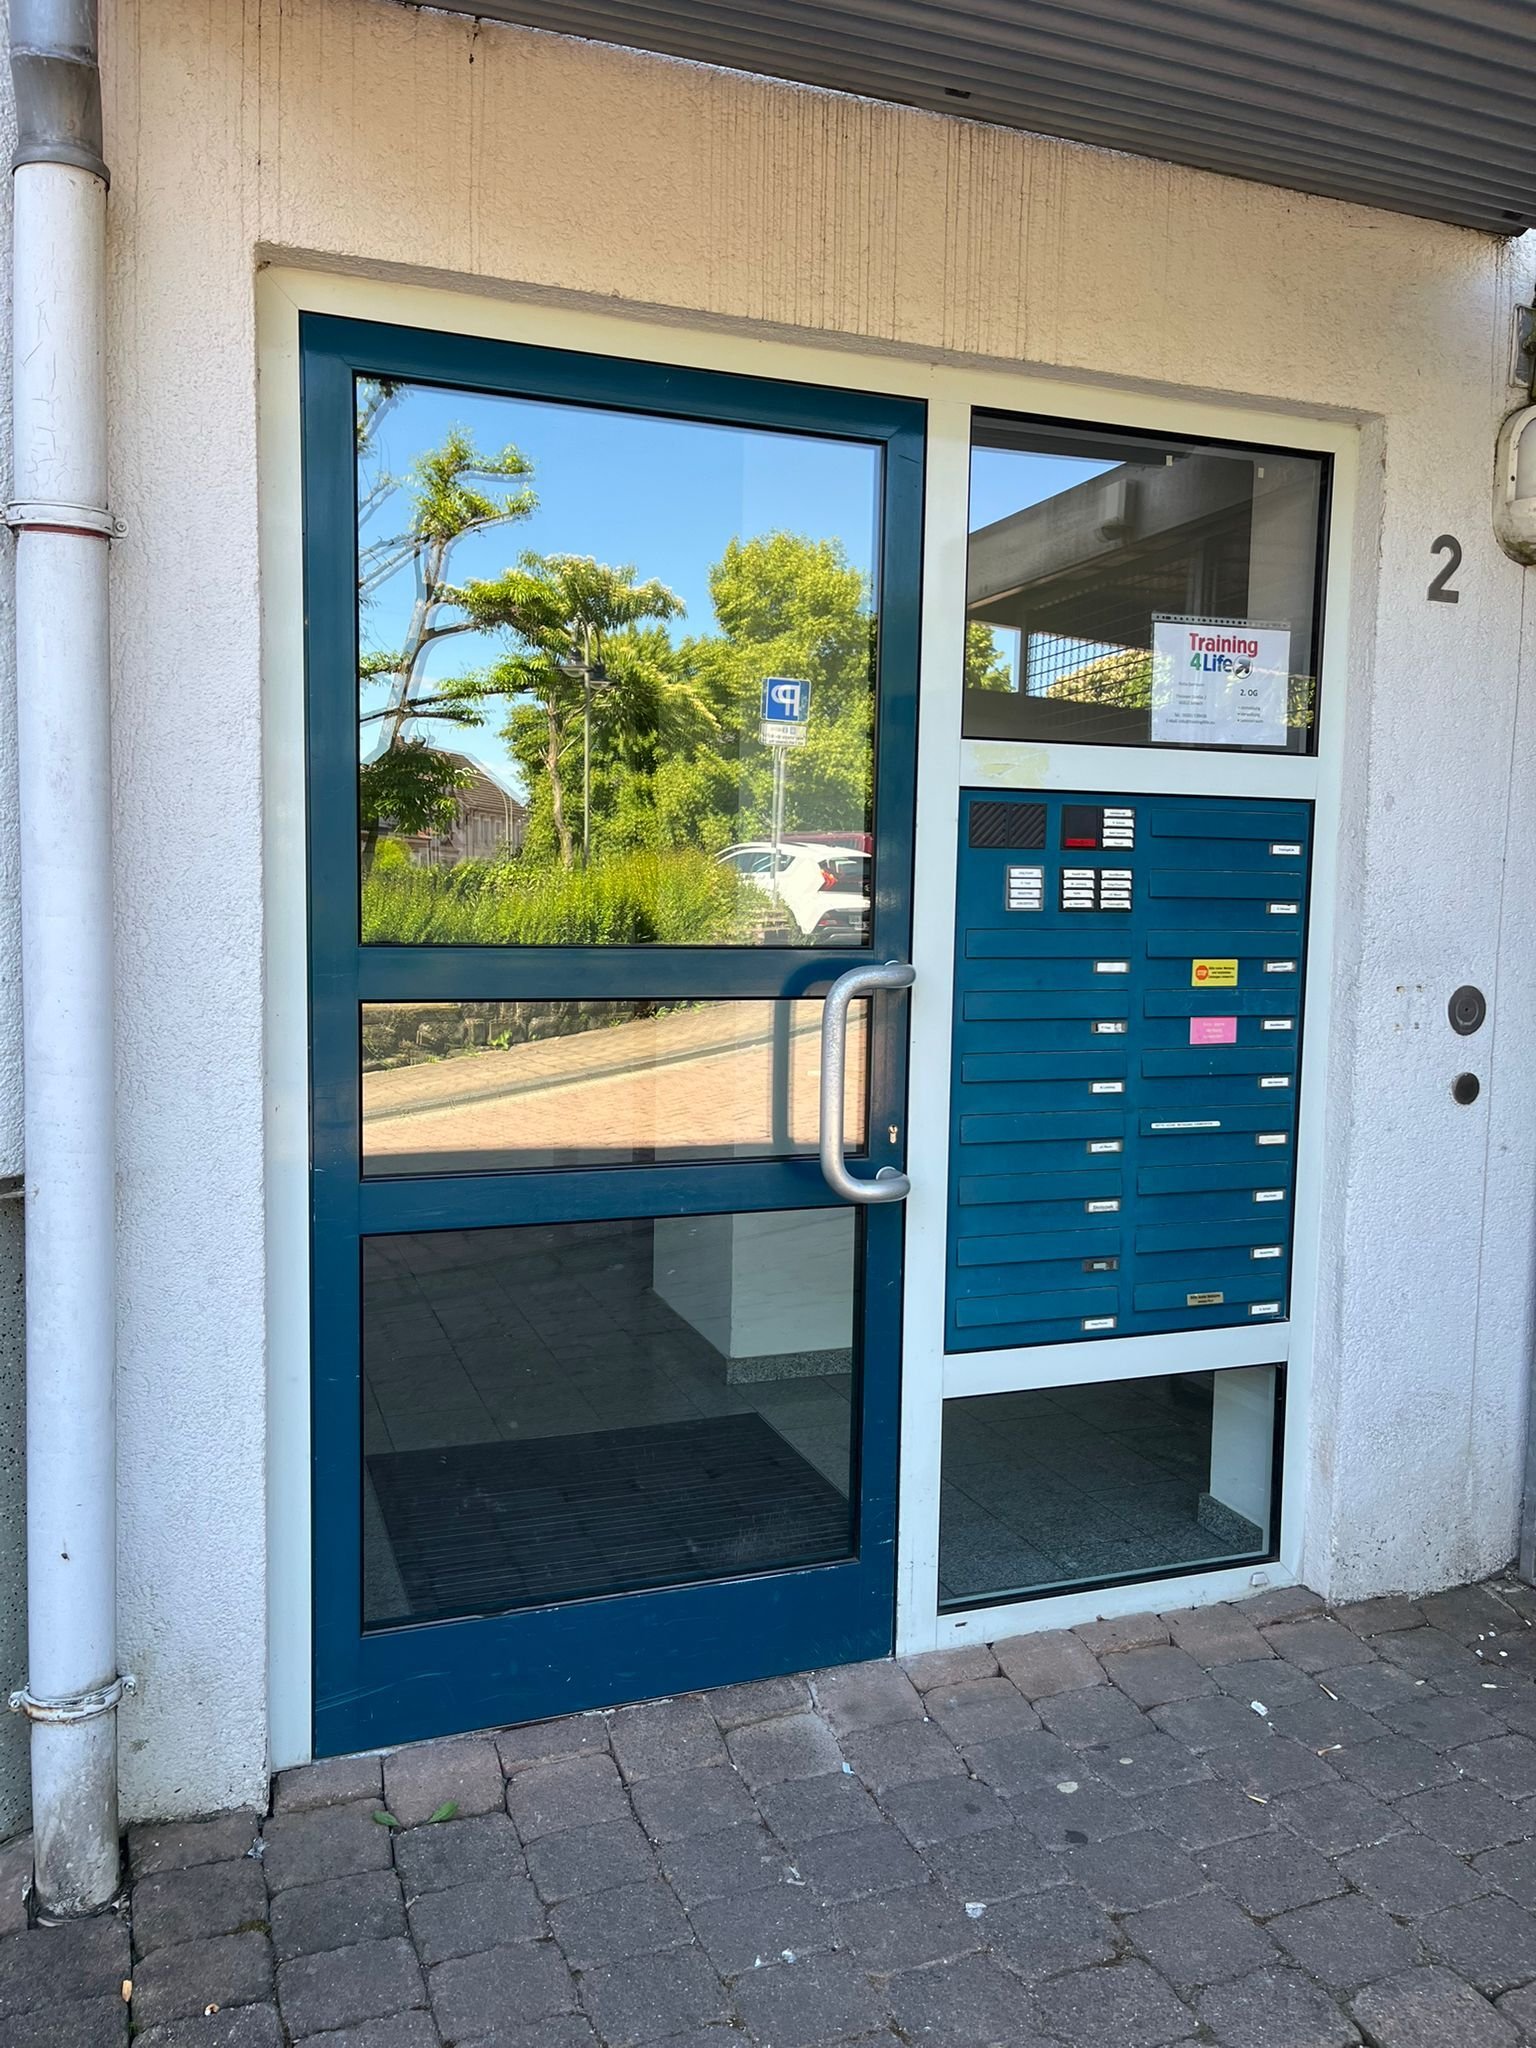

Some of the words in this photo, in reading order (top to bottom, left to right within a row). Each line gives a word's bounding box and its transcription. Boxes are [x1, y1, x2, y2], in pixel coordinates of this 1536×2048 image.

[1427, 534, 1462, 604] 2
[1188, 632, 1259, 658] Training
[1189, 652, 1233, 673] 4Life
[1240, 689, 1247, 697] 2.
[1247, 689, 1258, 697] OG
